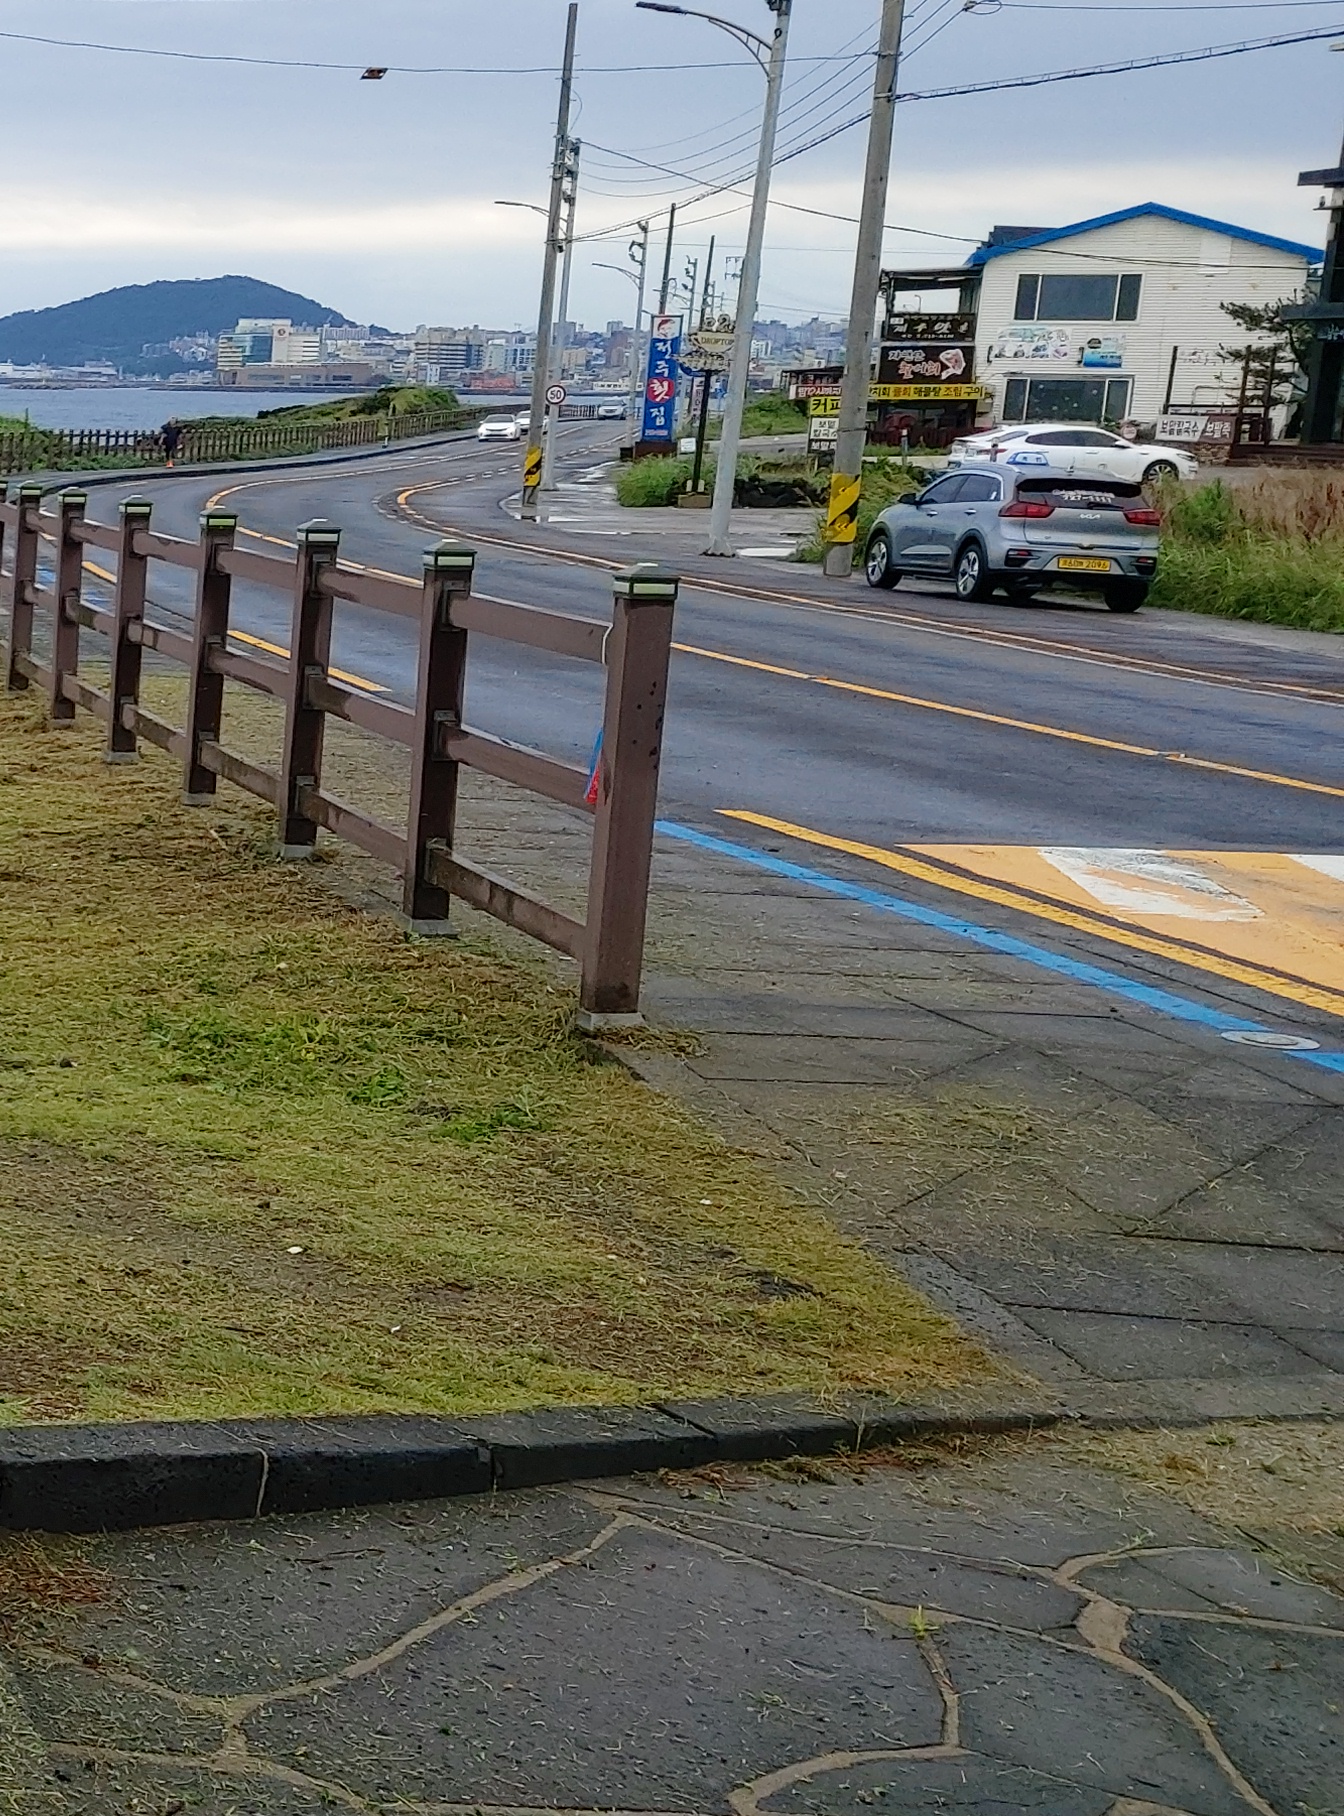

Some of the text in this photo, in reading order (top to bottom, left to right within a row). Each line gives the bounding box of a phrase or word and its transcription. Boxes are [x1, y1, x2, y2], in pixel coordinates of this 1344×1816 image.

[550, 389, 561, 400] 50
[1161, 420, 1200, 436] 보말칼국수
[1205, 421, 1231, 438] 보말죽
